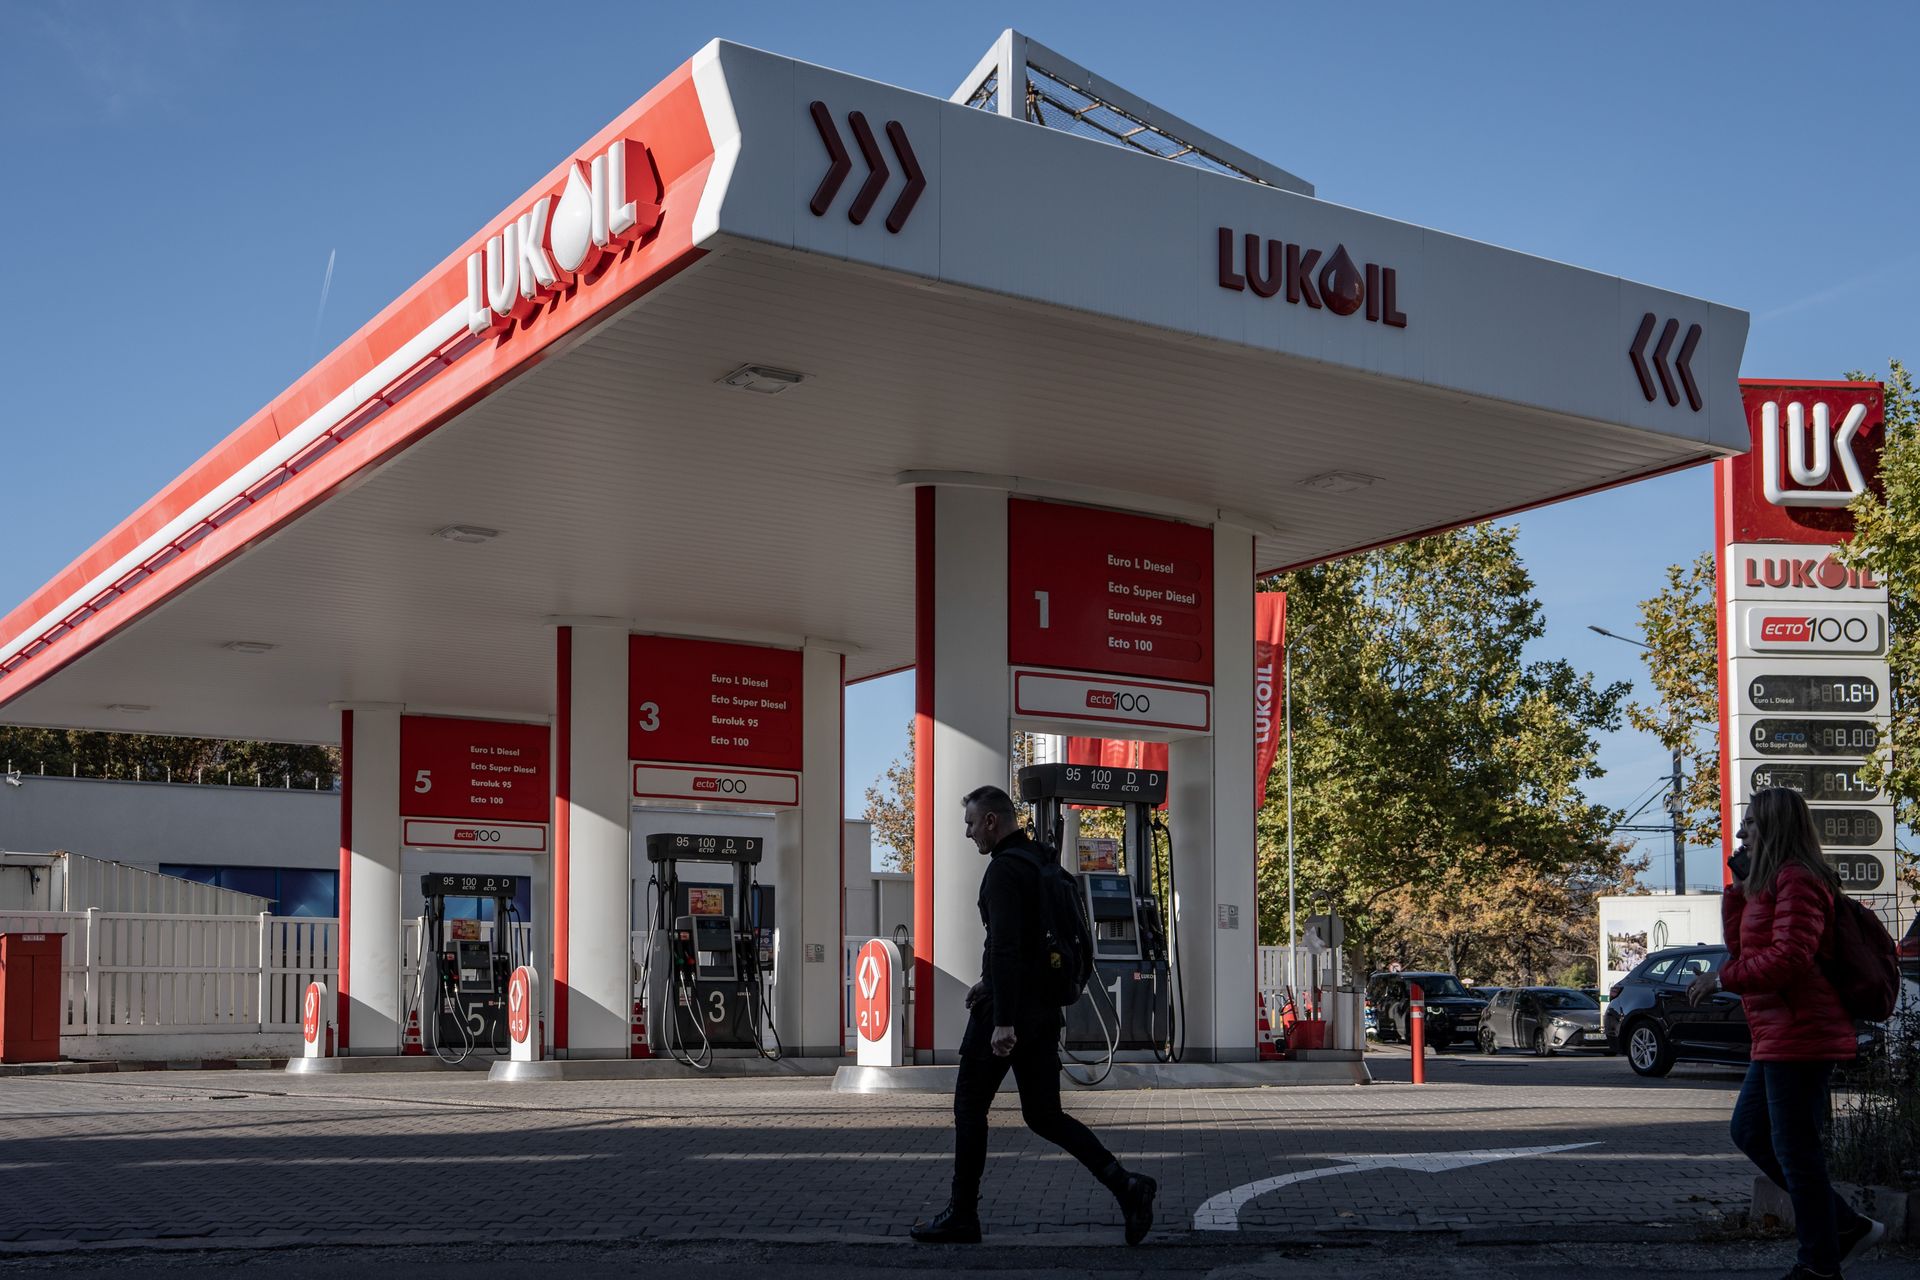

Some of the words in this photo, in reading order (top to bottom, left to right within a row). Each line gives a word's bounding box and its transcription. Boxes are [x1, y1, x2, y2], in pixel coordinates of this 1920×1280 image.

[466, 140, 640, 336] LUKOIL
[1219, 227, 1407, 328] LUKOIL
[1107, 554, 1132, 568] Euro
[1134, 558, 1140, 569] L
[1143, 559, 1174, 574] Diesel
[1745, 553, 1880, 589] LUKOIL
[1108, 581, 1130, 595] Ecto
[1133, 585, 1163, 600] Super
[1165, 589, 1195, 605] Diesel
[1034, 590, 1049, 629] 1
[1108, 609, 1147, 625] Euroluk
[1149, 614, 1163, 626] 95
[1108, 636, 1130, 649] Ecto
[1134, 639, 1153, 652] 100
[711, 673, 732, 684] Euro
[734, 676, 740, 685] L
[742, 676, 769, 688] Diesel
[1753, 683, 1765, 697] D
[1833, 683, 1874, 703] 7.64
[711, 695, 730, 705] Ecto
[732, 696, 758, 708] Super
[761, 698, 787, 711] Diesel
[1256, 664, 1272, 744] LUKOIL
[639, 701, 660, 732] 3
[711, 715, 745, 727] Euroluk
[747, 718, 759, 728] 95
[711, 736, 730, 745] Ecto
[733, 737, 749, 747] 100
[1755, 727, 1766, 741] D
[1774, 732, 1805, 741] ECTO
[470, 745, 488, 754] Euro
[490, 747, 495, 755] L
[497, 747, 520, 757] Diesel
[471, 762, 487, 771] Ecto
[489, 764, 511, 774] Super
[513, 765, 536, 775] Diesel
[1066, 767, 1081, 782] 95
[1090, 769, 1112, 784] 100
[1127, 771, 1137, 785] D
[1149, 773, 1158, 786] D
[414, 770, 432, 794] 5
[471, 779, 500, 788] Euroluk
[502, 781, 512, 789] 95
[1091, 782, 1110, 790] ECTO
[1121, 784, 1139, 792] ECTO
[1756, 772, 1771, 786] 95
[470, 795, 487, 804] Ecto
[490, 796, 504, 805] 100
[676, 836, 689, 848] 95
[697, 837, 716, 849] 100
[726, 838, 734, 849] D
[746, 839, 755, 850] D
[443, 876, 455, 886] 95
[462, 877, 477, 887] 100
[487, 878, 494, 887] D
[502, 878, 510, 888] D
[708, 990, 726, 1023] 3
[1107, 975, 1122, 1028] 1
[466, 1002, 485, 1037] 5
[518, 1020, 523, 1031] 3
[861, 1010, 868, 1027] 2
[874, 1010, 880, 1027] 1
